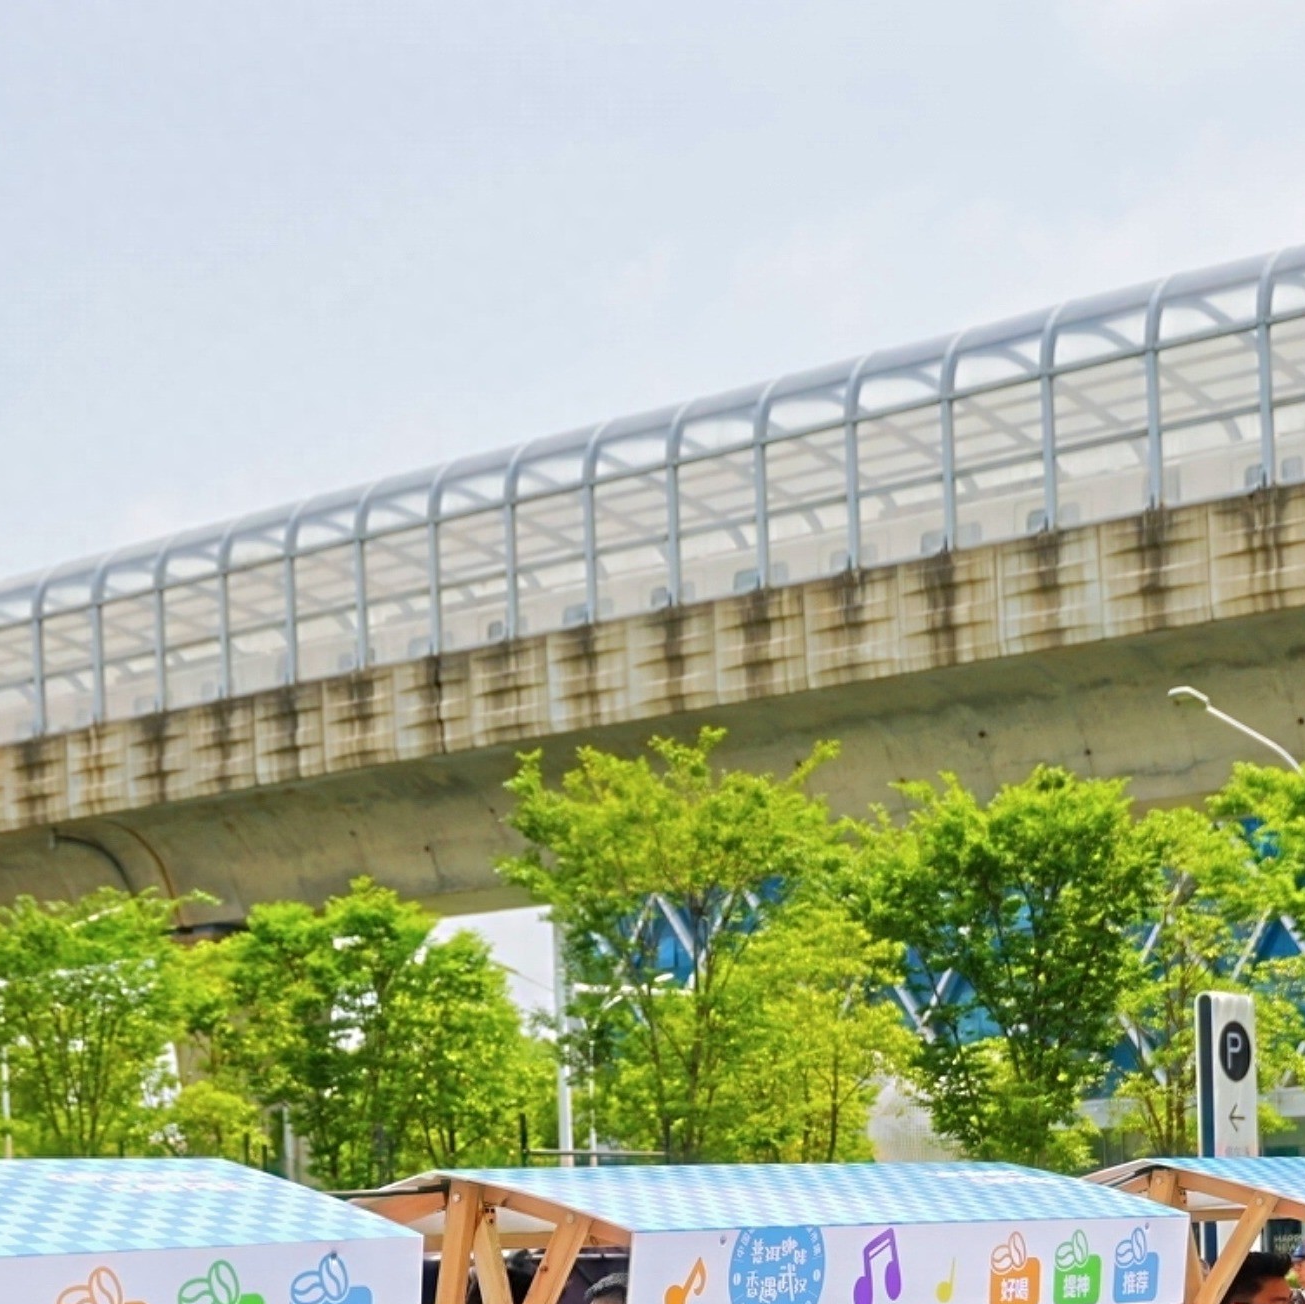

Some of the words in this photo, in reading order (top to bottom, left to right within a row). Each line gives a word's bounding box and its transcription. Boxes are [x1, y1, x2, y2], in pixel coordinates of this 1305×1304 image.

[1227, 1032, 1242, 1069] P
[1000, 1277, 1029, 1302] 好喝
[1063, 1274, 1090, 1298] 提神
[1122, 1271, 1149, 1295] 推荐
